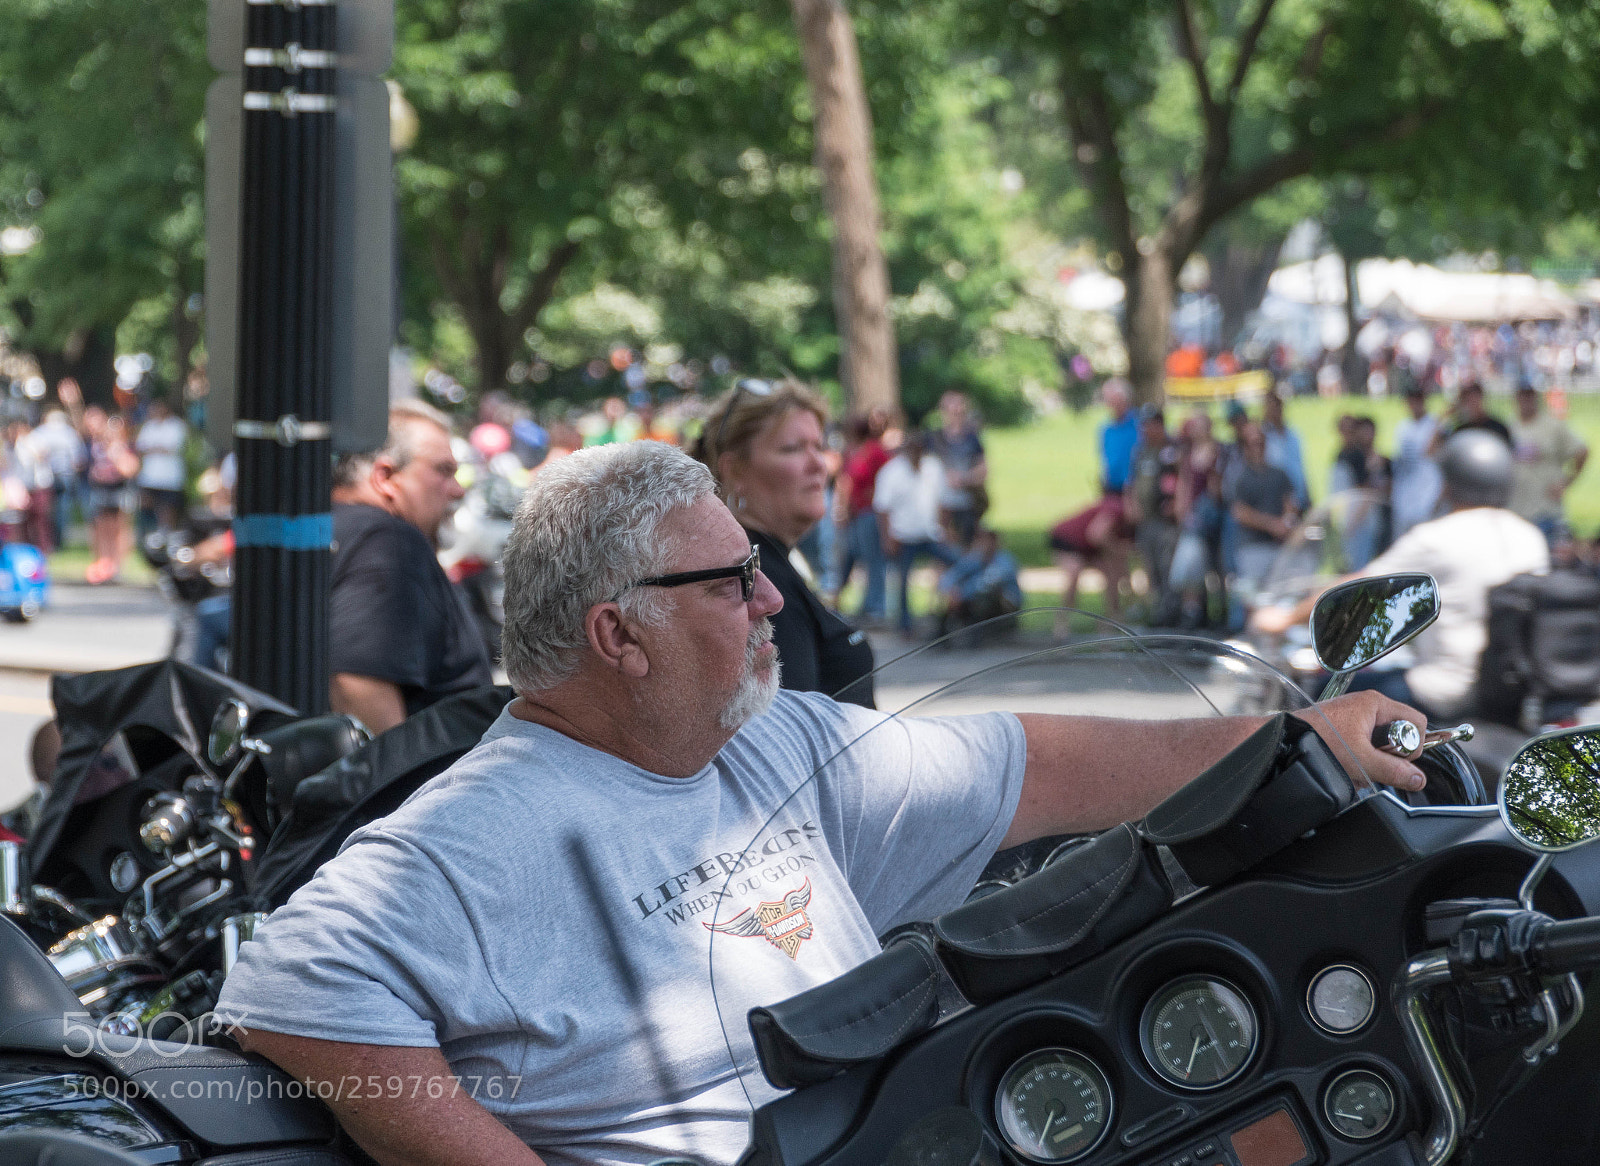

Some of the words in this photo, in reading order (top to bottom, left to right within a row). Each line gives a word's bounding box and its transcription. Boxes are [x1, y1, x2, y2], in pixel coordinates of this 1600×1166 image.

[631, 858, 722, 920] LIFE
[663, 886, 733, 926] WHEN
[736, 876, 762, 896] OU
[1080, 1088, 1091, 1098] 100
